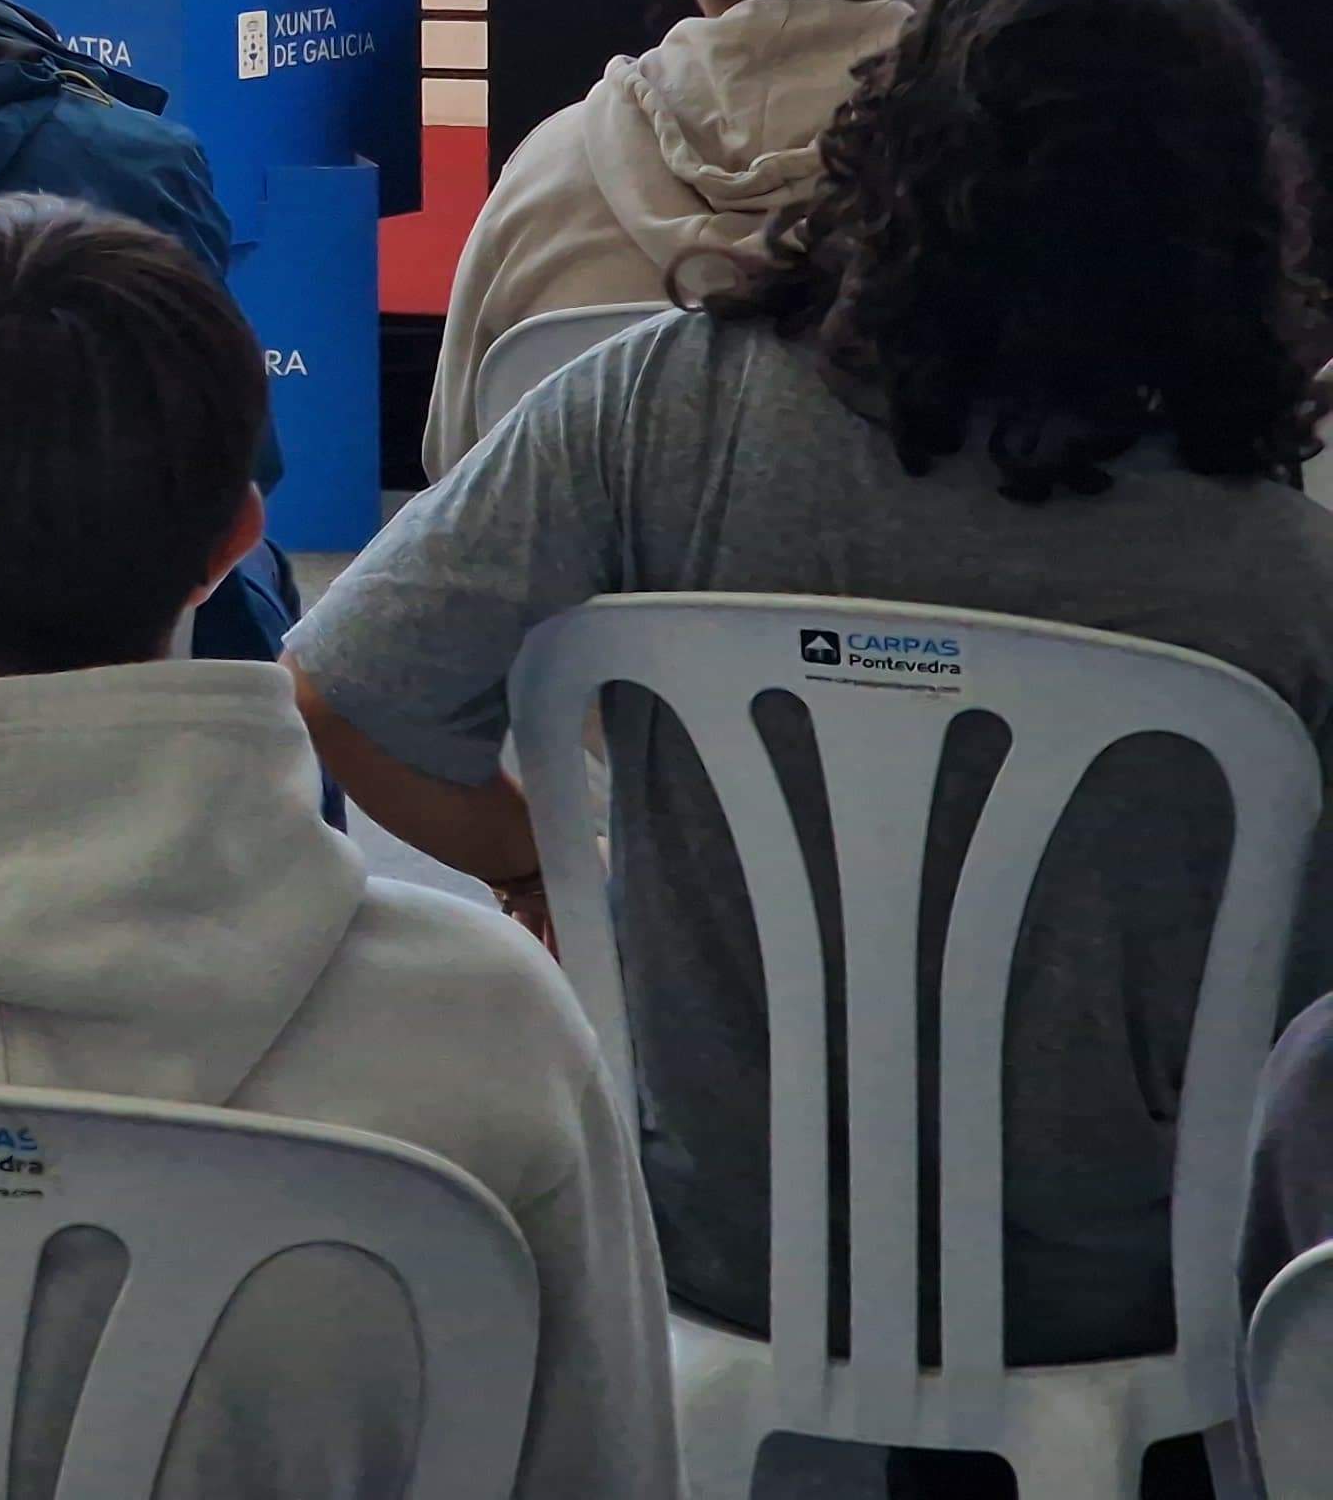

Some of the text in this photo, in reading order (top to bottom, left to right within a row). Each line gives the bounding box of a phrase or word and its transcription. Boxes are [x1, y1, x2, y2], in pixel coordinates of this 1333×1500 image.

[274, 7, 336, 37] XUNTA
[274, 32, 375, 67] DE GALICIA
[847, 633, 961, 657] CARPAS
[849, 653, 962, 675] Pontevedra
